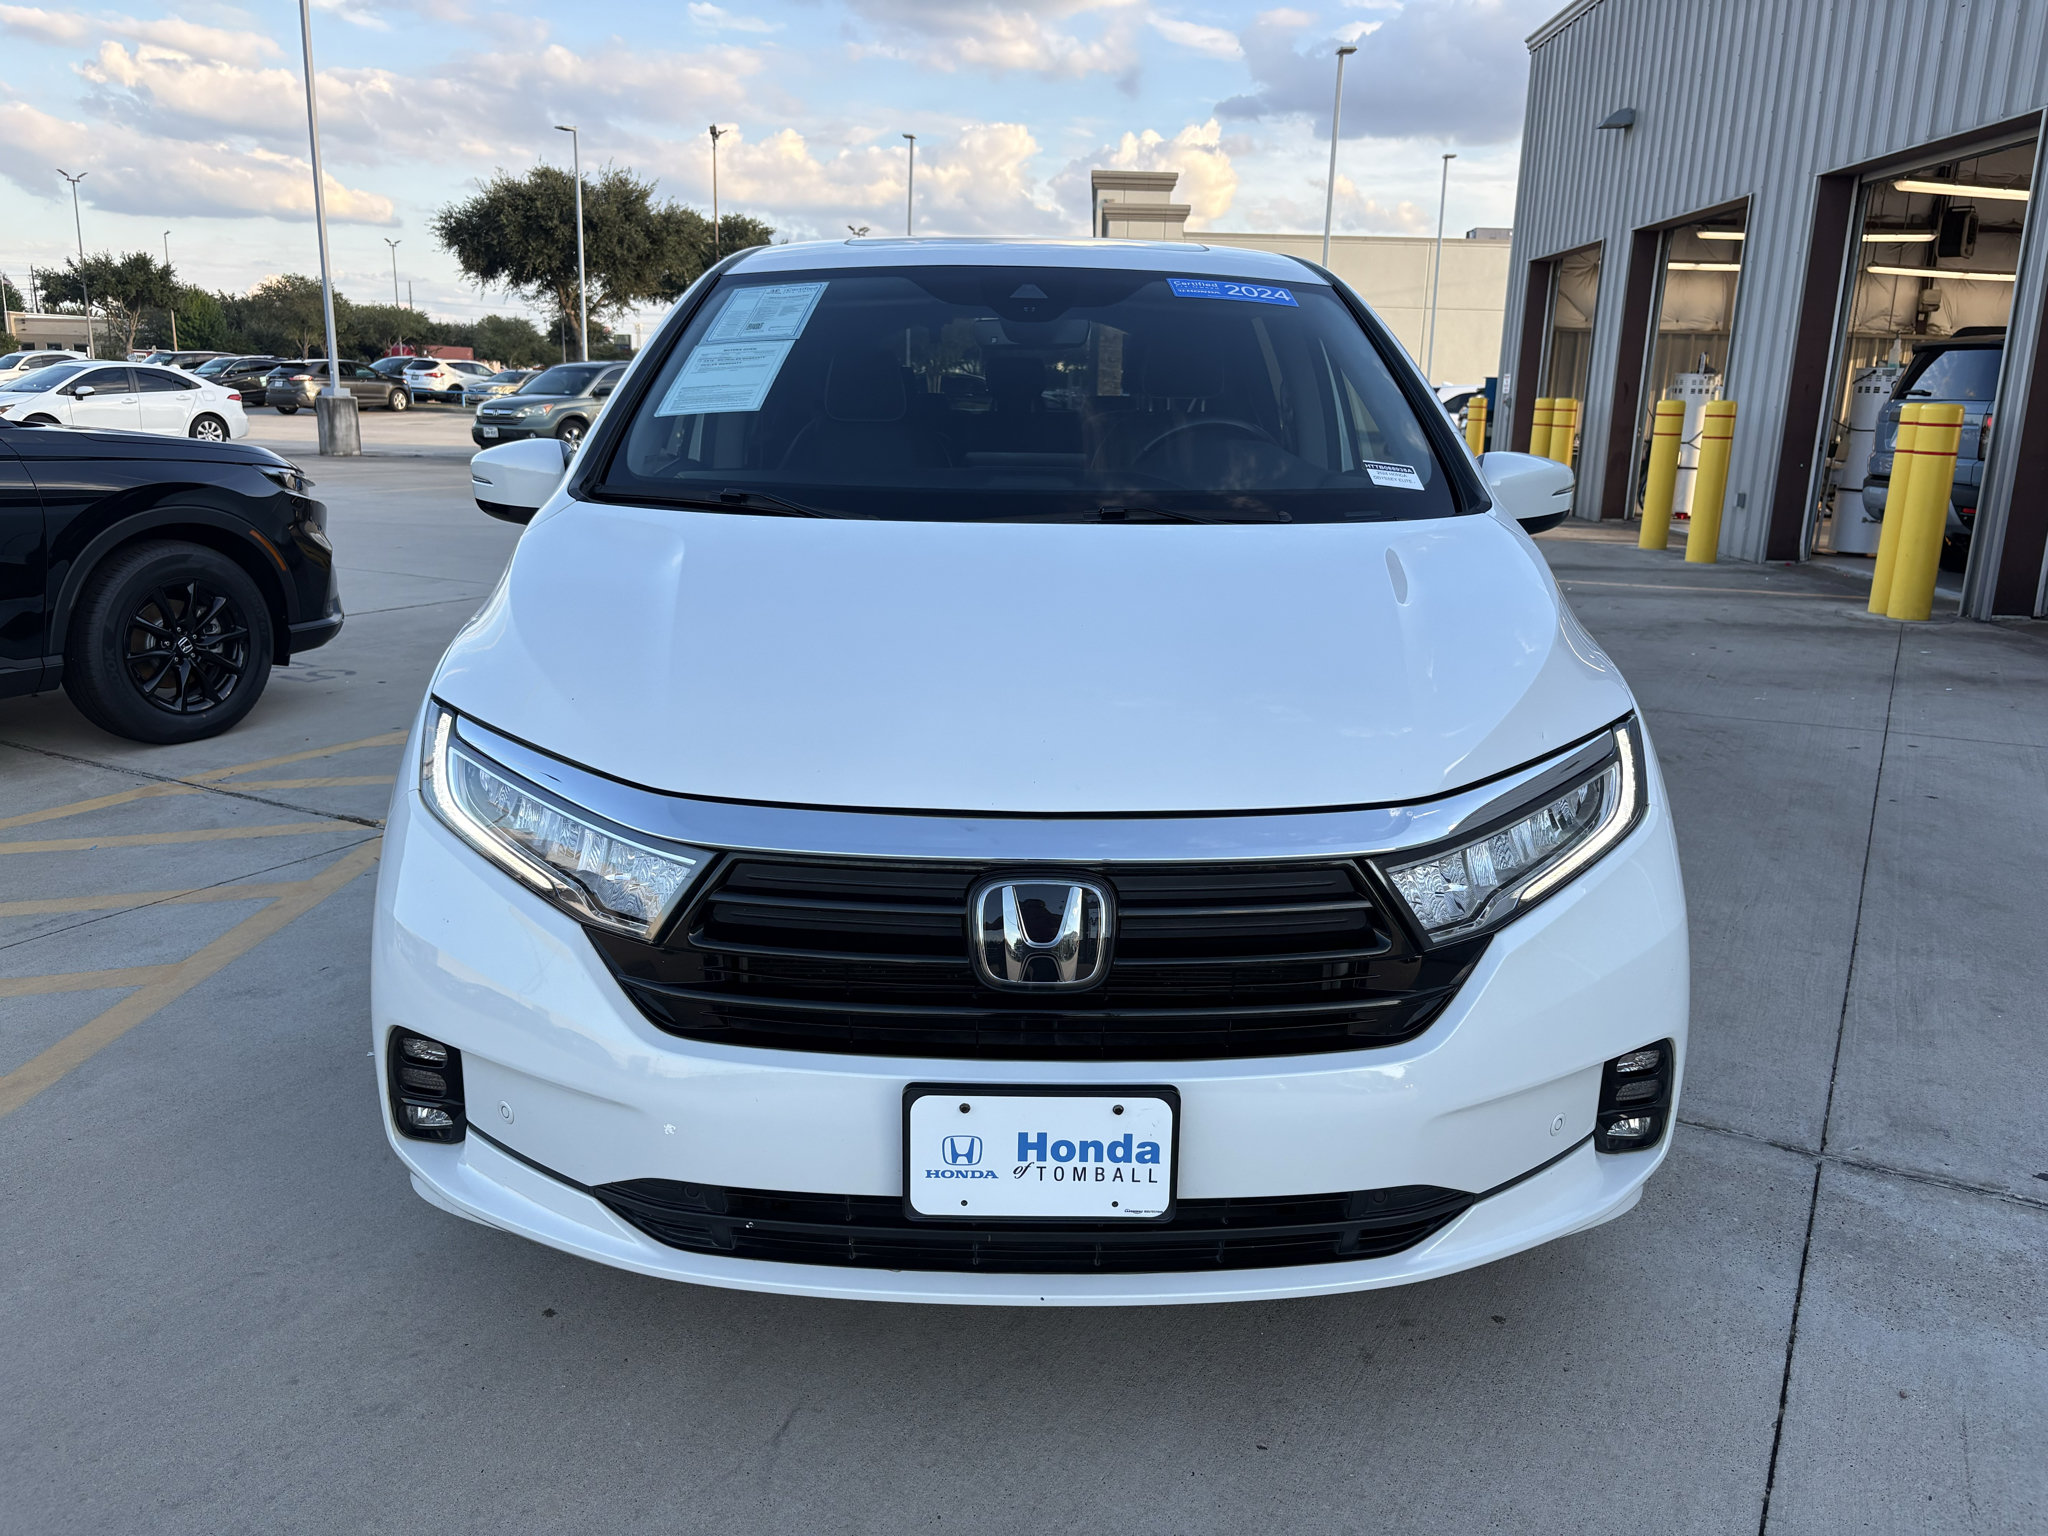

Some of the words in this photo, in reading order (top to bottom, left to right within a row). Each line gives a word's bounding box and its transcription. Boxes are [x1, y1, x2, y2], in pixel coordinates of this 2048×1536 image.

[1224, 284, 1291, 301] 2024
[1017, 1132, 1160, 1165] Honda
[925, 1169, 999, 1179] HONDA
[1012, 1162, 1035, 1179] of
[1037, 1166, 1158, 1183] TOMBALL
